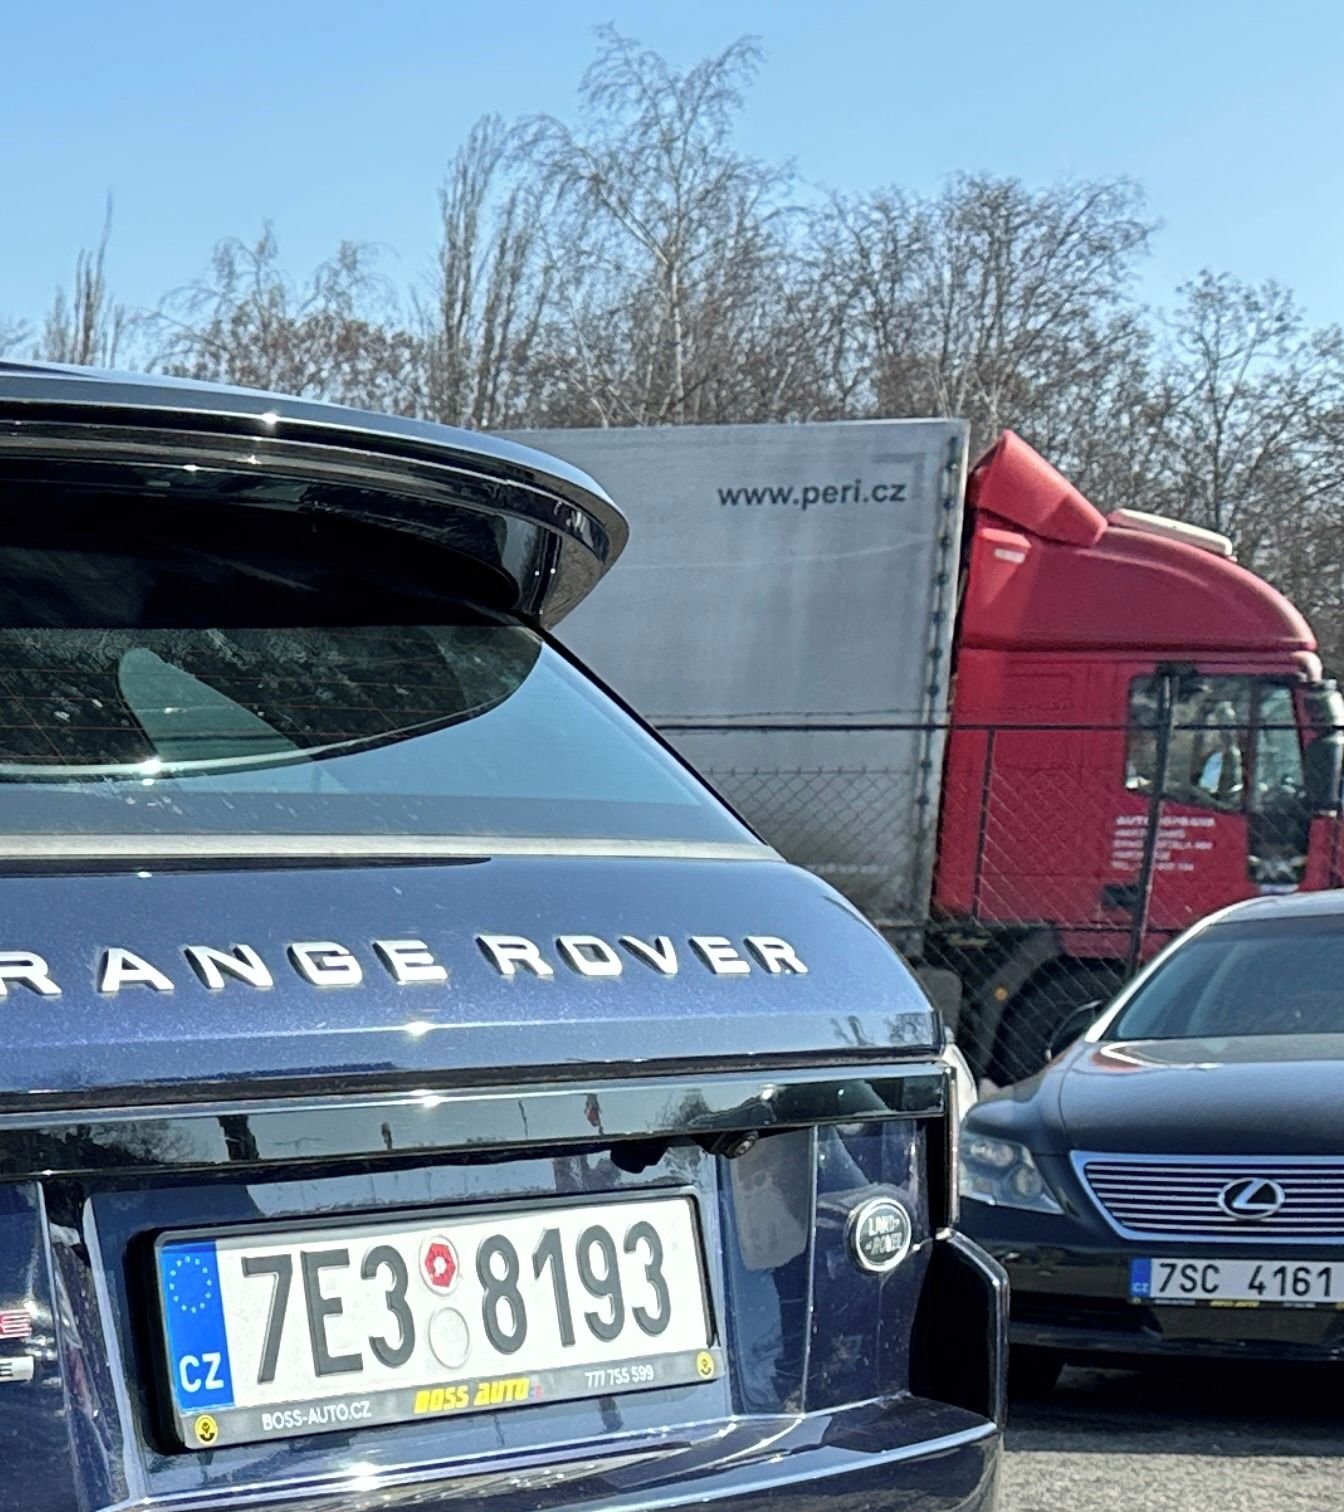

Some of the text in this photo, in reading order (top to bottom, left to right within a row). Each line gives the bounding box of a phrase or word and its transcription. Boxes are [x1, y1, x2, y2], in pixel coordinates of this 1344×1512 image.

[717, 478, 907, 511] www.peri.cz
[477, 934, 809, 978] ROVER
[1158, 1262, 1333, 1298] 7SC 4161
[241, 1220, 672, 1386] 7E3 8193
[178, 1351, 225, 1394] CZ
[584, 1364, 654, 1389] 777 755 599
[261, 1401, 372, 1431] BOSS-AUTO.CZ
[414, 1385, 469, 1414] BOSS
